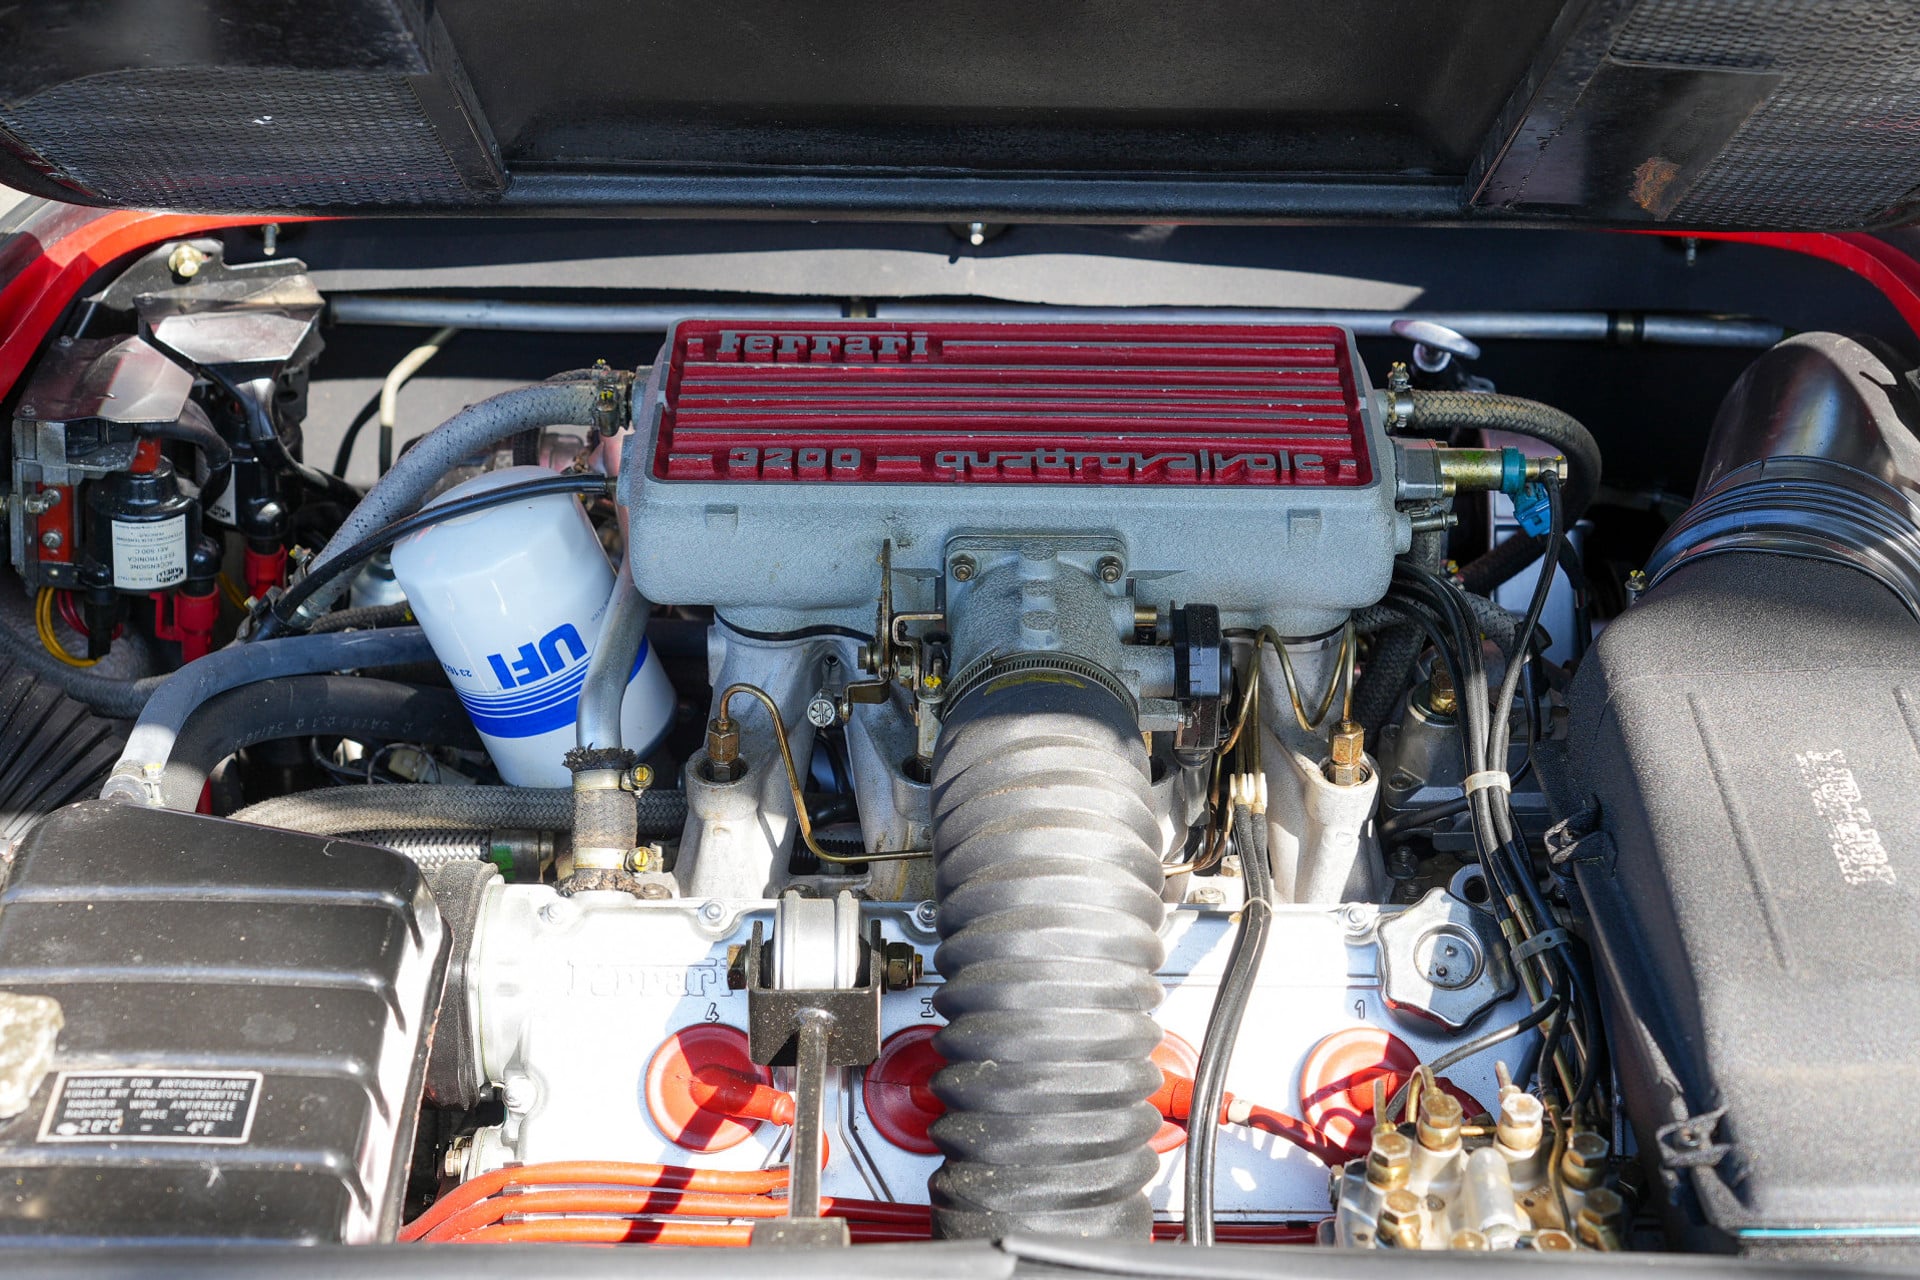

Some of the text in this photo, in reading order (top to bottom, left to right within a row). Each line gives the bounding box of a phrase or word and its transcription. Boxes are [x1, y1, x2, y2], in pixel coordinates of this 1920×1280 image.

[719, 330, 928, 355] Ferrari
[728, 447, 1326, 472] 3200 quattrovalvole
[487, 623, 587, 690] UFI
[459, 669, 472, 678] 23
[704, 1002, 720, 1023] 4
[920, 997, 937, 1018] 3
[1354, 999, 1366, 1020] 1
[129, 1099, 158, 1109] WITH
[169, 1100, 238, 1111] ANTIFREEZE
[139, 1109, 168, 1119] AVEC
[184, 1110, 234, 1121] ANTIGEL
